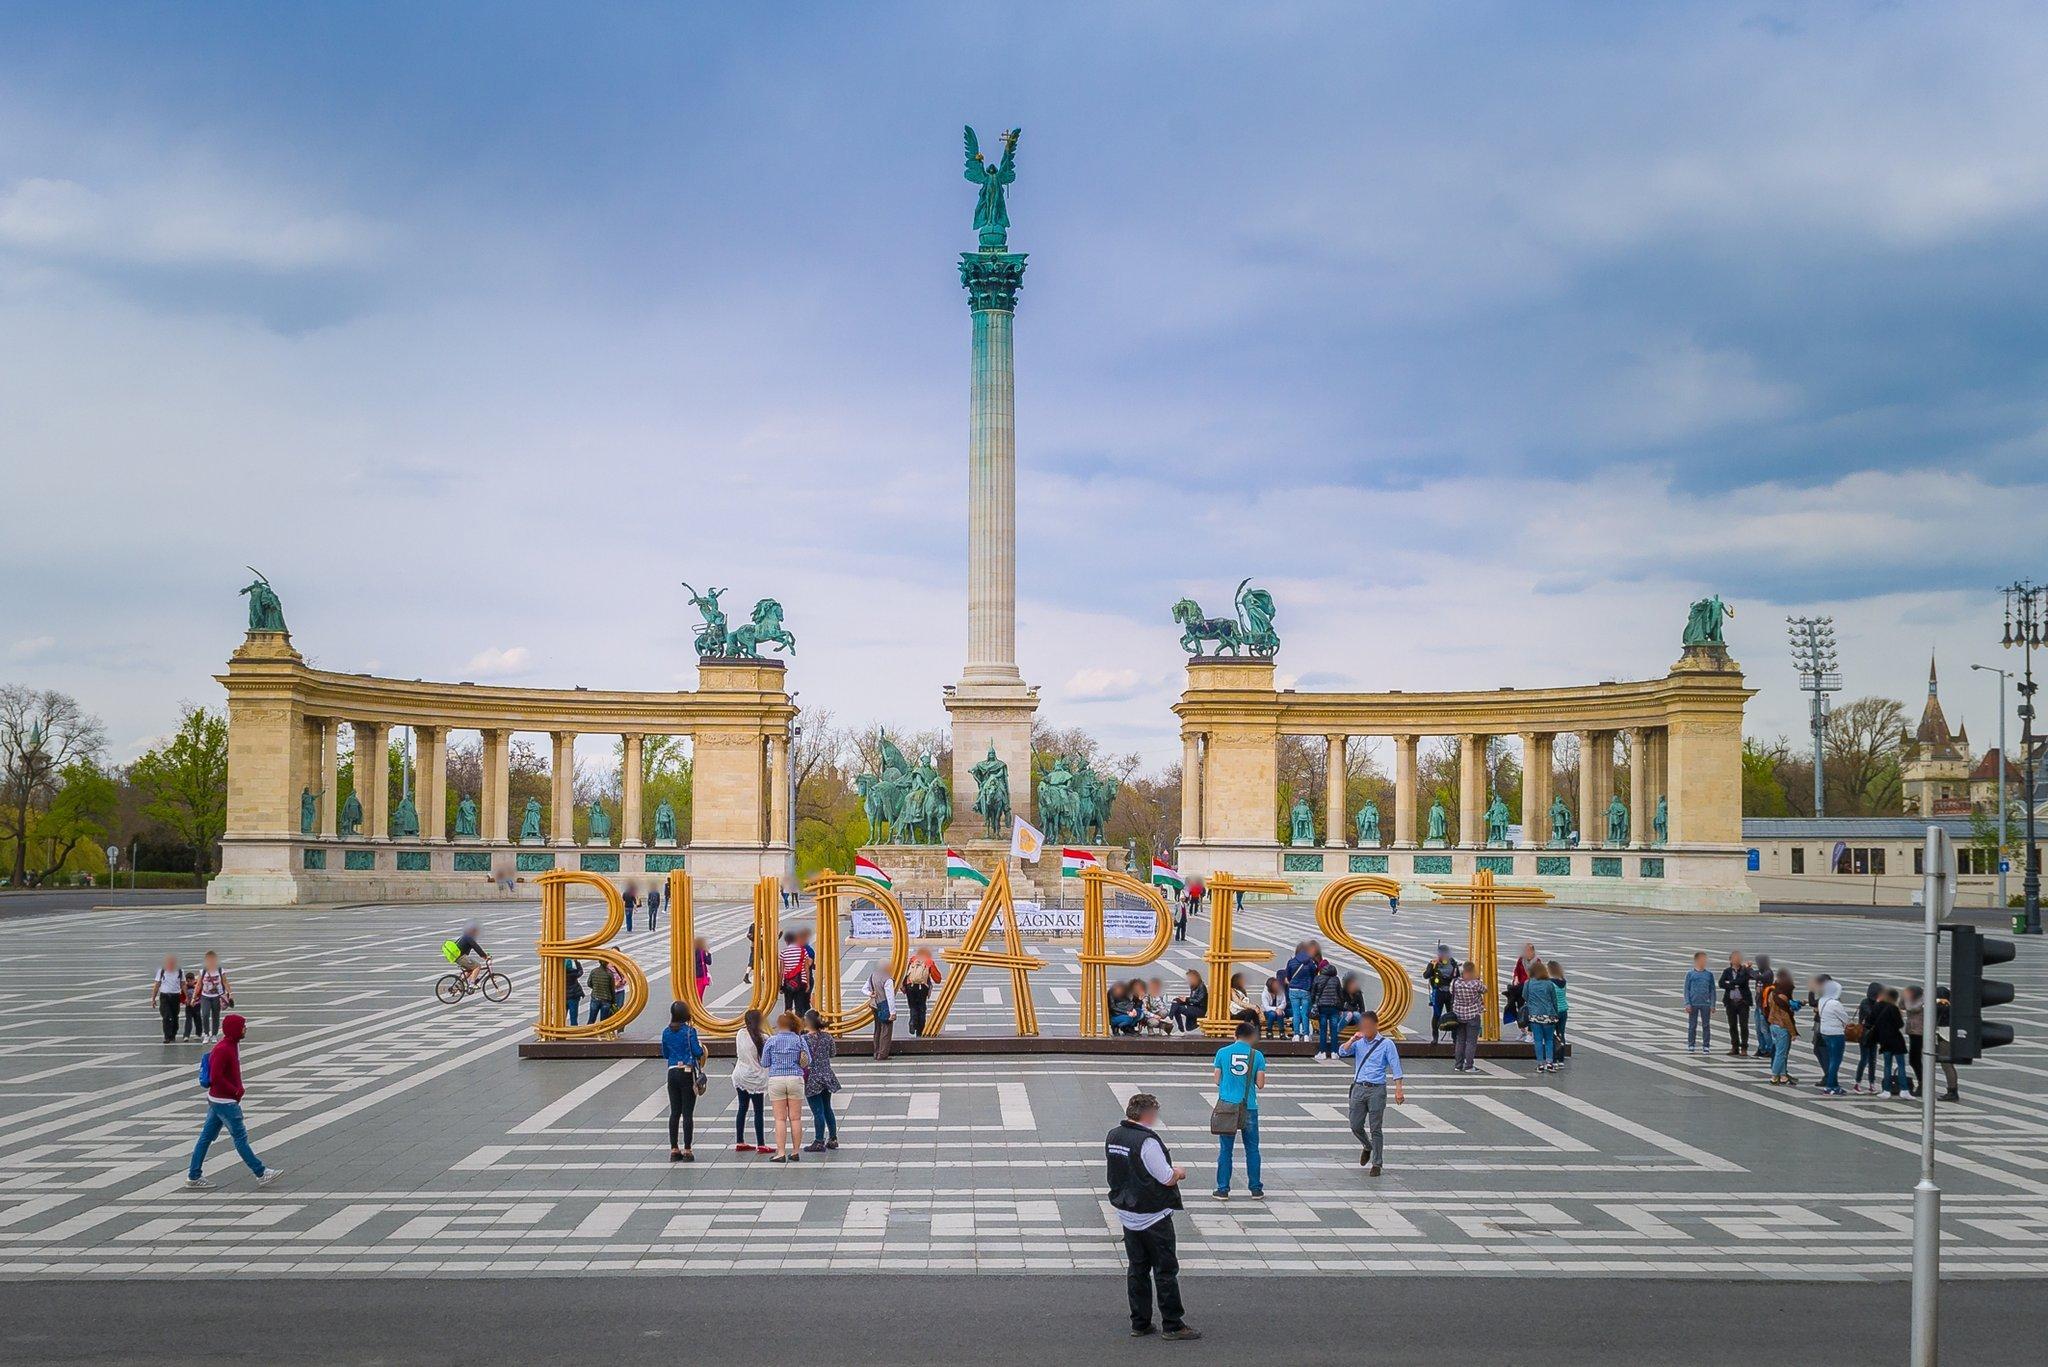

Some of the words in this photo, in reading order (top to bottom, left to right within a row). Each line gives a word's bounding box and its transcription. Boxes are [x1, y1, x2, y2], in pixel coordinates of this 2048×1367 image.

[997, 911, 1081, 928] VÁGNAK!
[532, 858, 1556, 1042] BUDAPEST
[1230, 1053, 1249, 1076] 5
